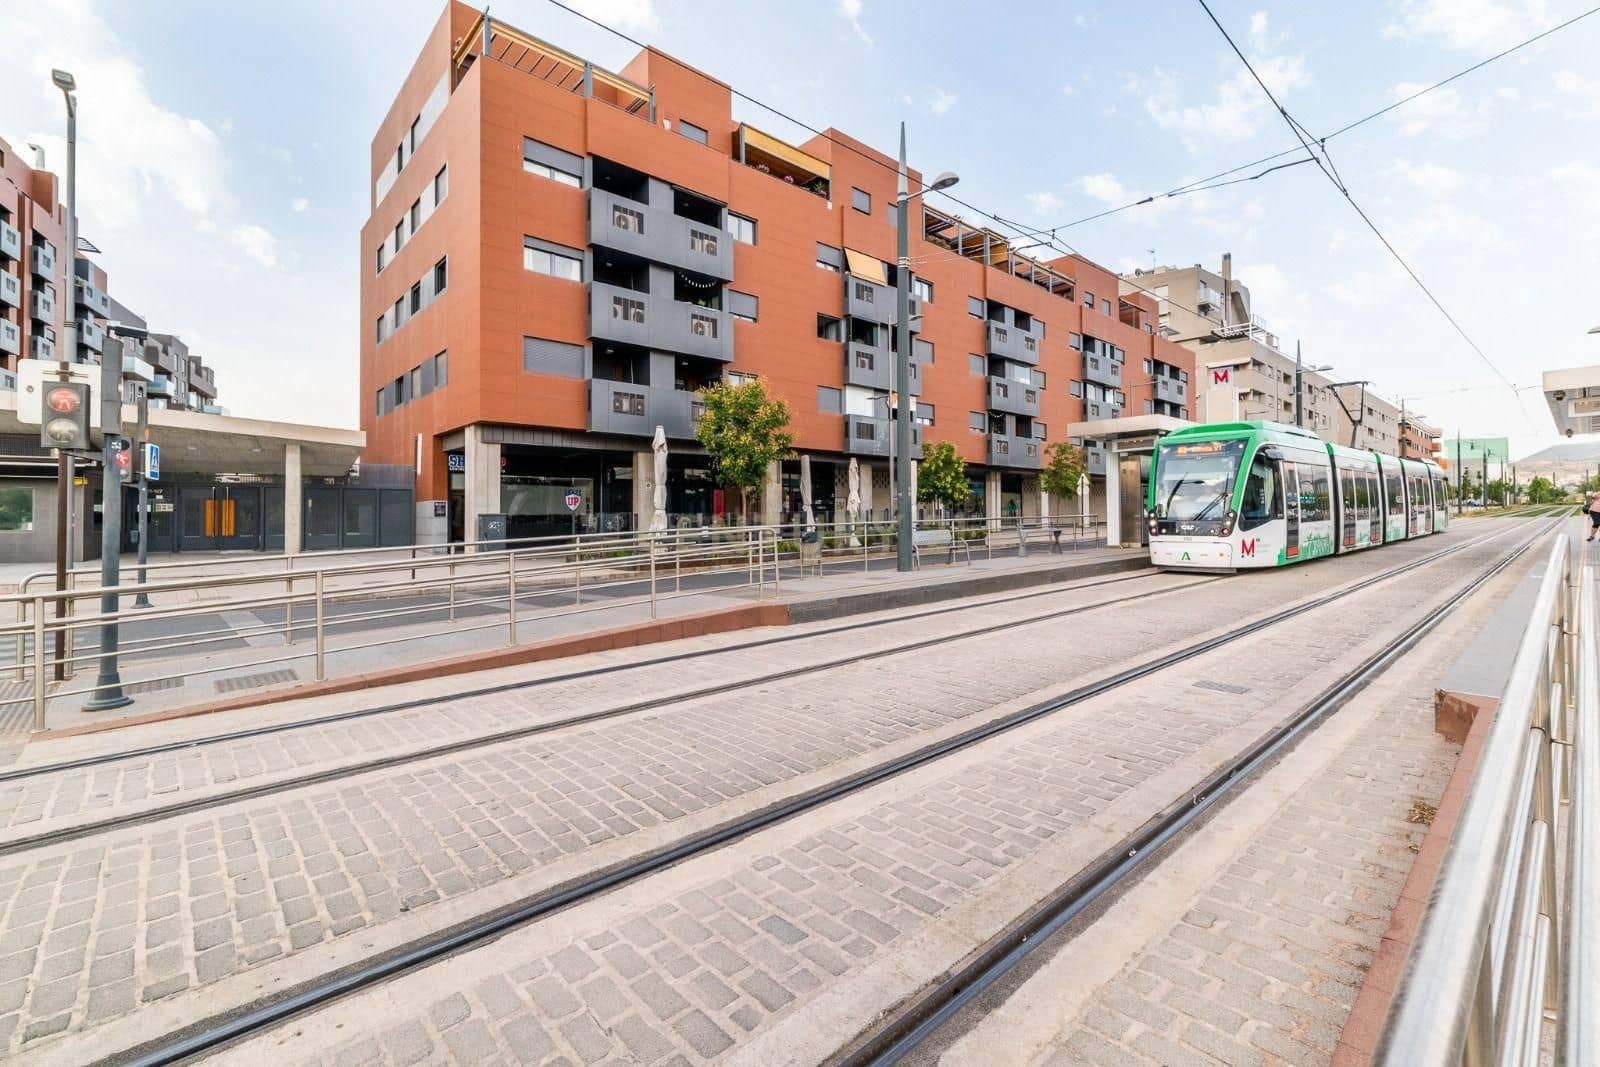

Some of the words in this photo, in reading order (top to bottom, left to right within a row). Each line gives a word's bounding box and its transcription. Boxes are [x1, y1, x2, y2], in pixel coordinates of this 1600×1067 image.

[1214, 367, 1229, 384] M
[568, 496, 579, 506] UP
[1241, 537, 1255, 557] M
